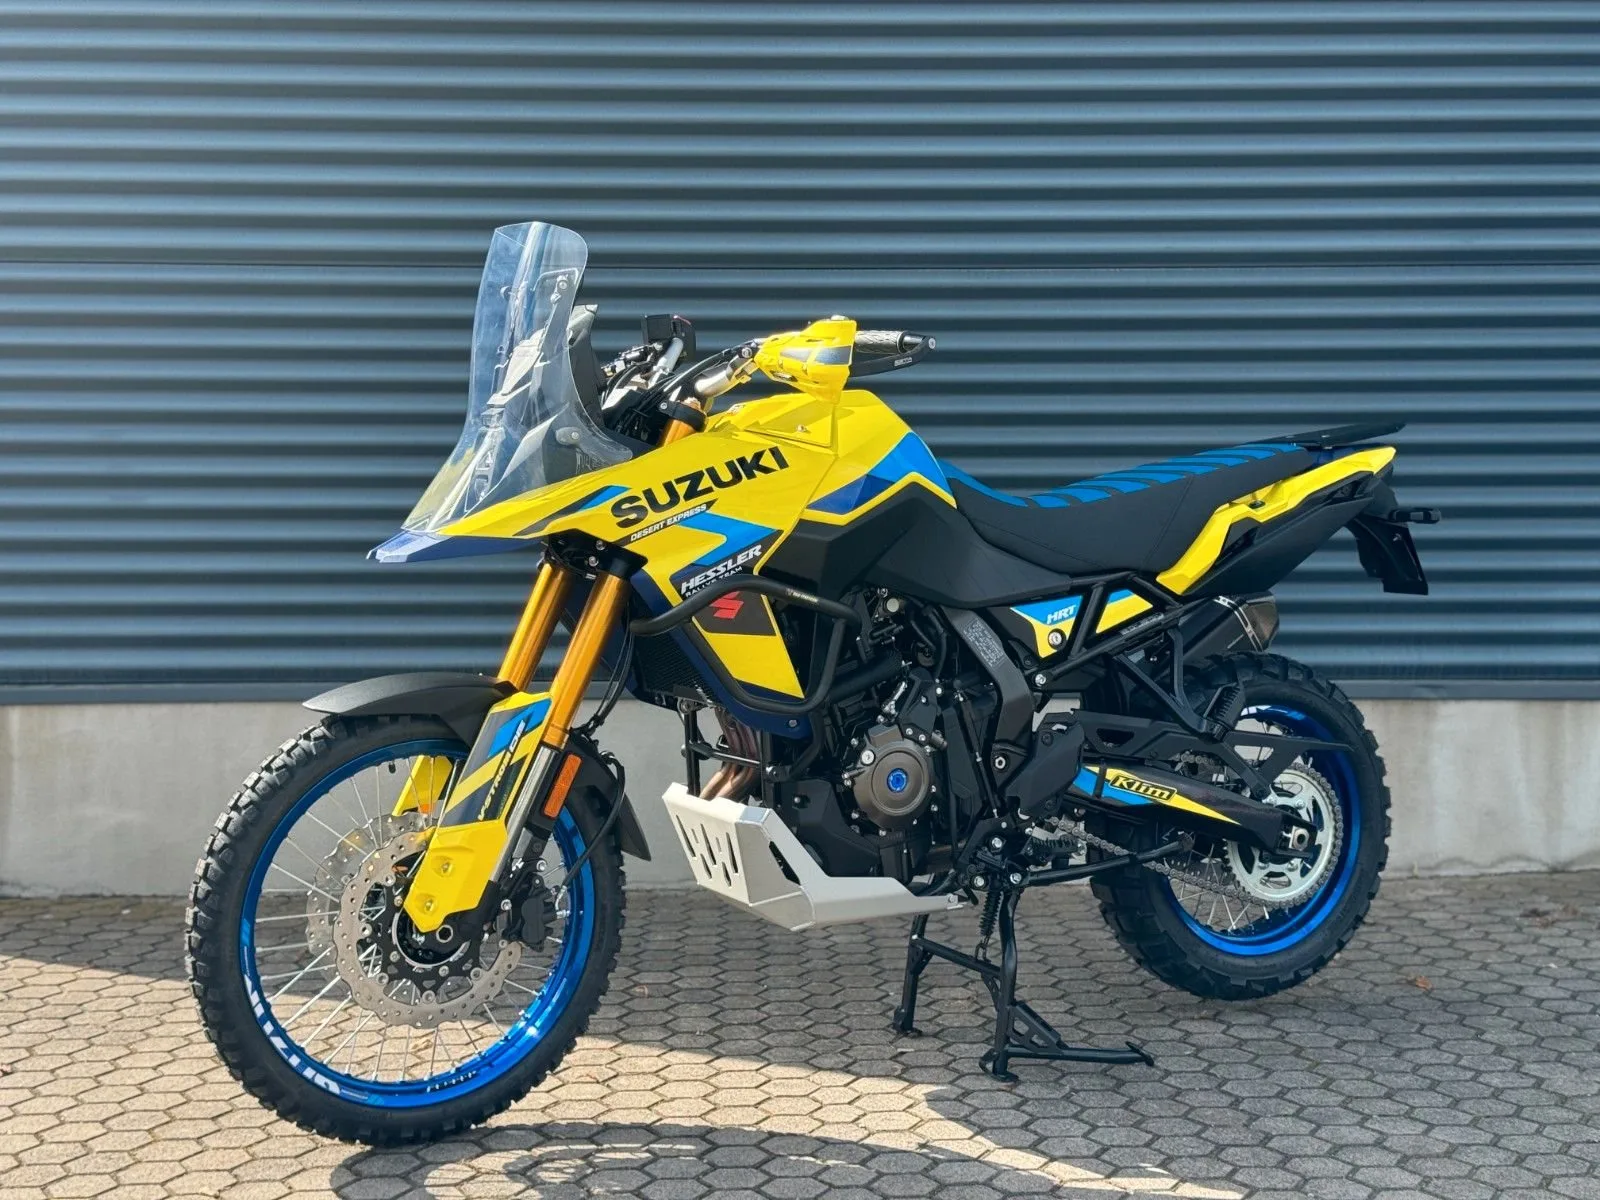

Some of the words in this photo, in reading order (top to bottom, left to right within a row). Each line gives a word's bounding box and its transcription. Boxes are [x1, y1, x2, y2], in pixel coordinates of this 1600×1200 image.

[611, 446, 789, 528] SUZUKI
[630, 523, 665, 542] DESERT
[667, 503, 707, 526] EXPRESS
[681, 544, 762, 594] HESSLER
[1046, 604, 1076, 625] HRT
[1113, 776, 1171, 799] Klim
